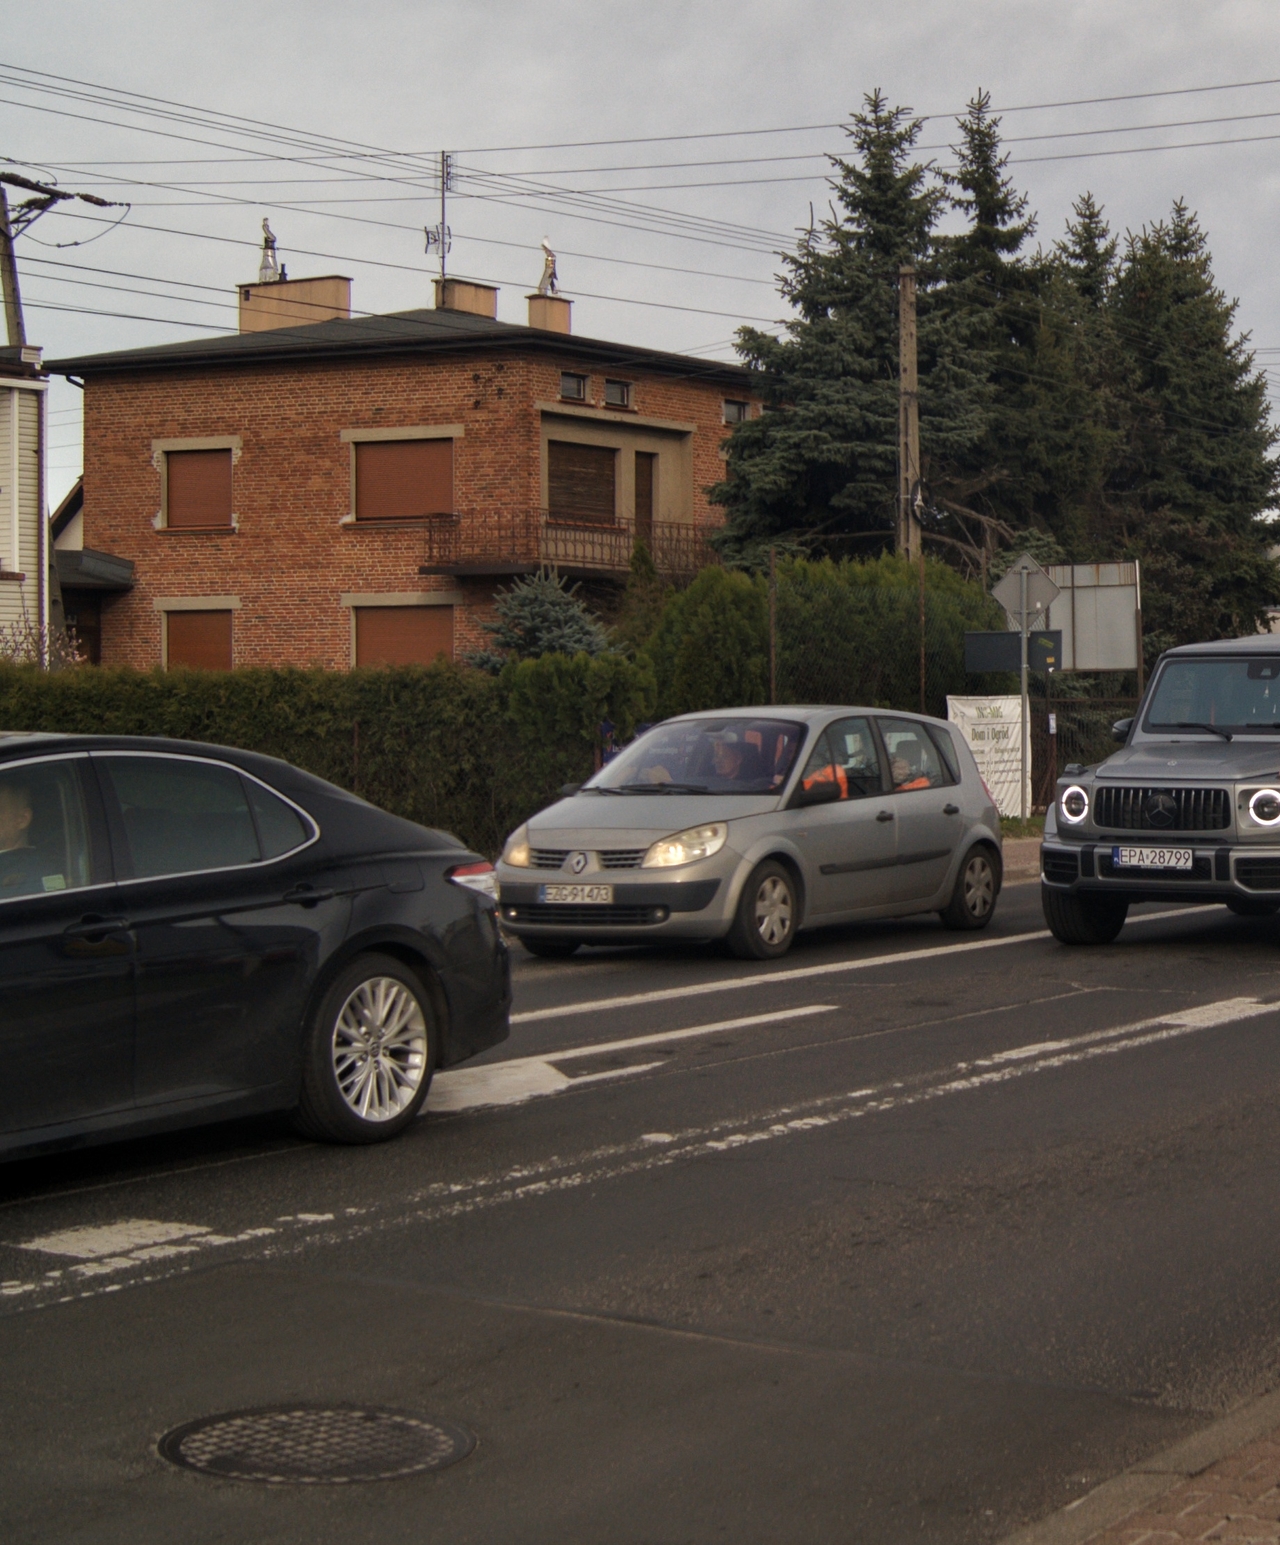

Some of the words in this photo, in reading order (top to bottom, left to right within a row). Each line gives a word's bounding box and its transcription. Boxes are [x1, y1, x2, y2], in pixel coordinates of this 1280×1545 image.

[971, 728, 985, 741] Dom
[1120, 848, 1146, 864] EPA
[1149, 849, 1191, 866] 28799
